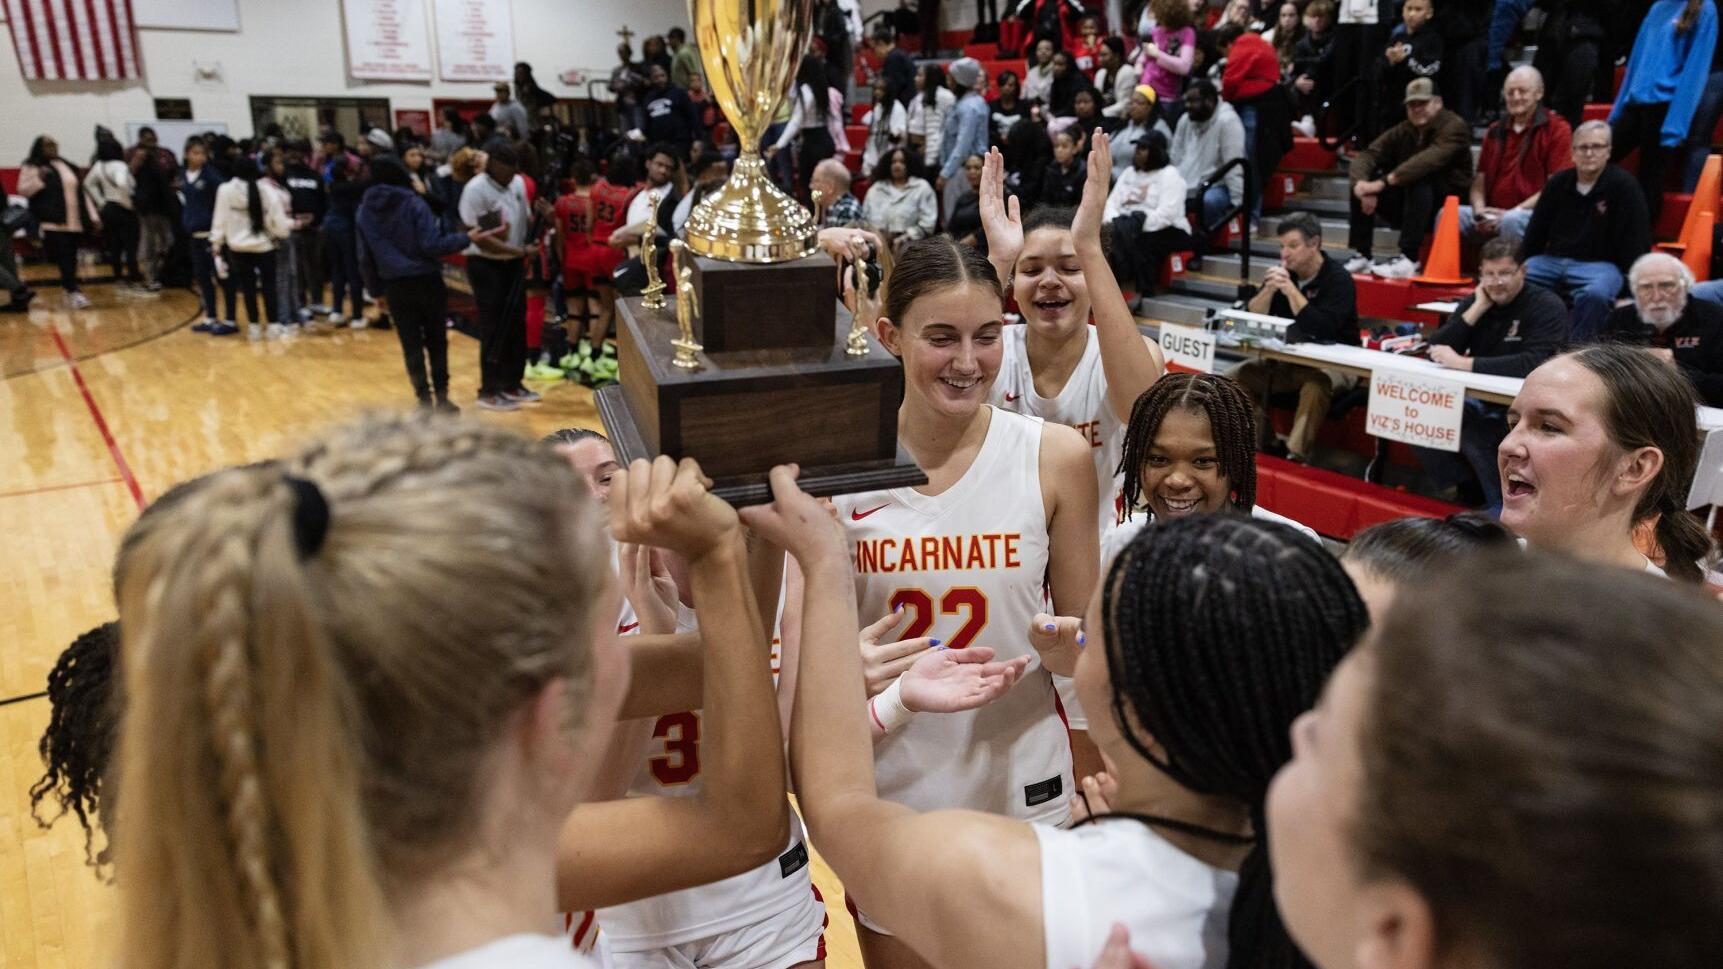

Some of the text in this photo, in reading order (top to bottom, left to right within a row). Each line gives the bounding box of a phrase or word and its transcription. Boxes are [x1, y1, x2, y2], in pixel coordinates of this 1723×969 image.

[1162, 332, 1210, 360] GUEST
[1377, 383, 1455, 408] WELCOME
[1404, 405, 1419, 418] to
[1371, 413, 1457, 441] VIZ'S HOUSE
[856, 533, 1022, 574] INCARNATE
[887, 585, 989, 650] 22
